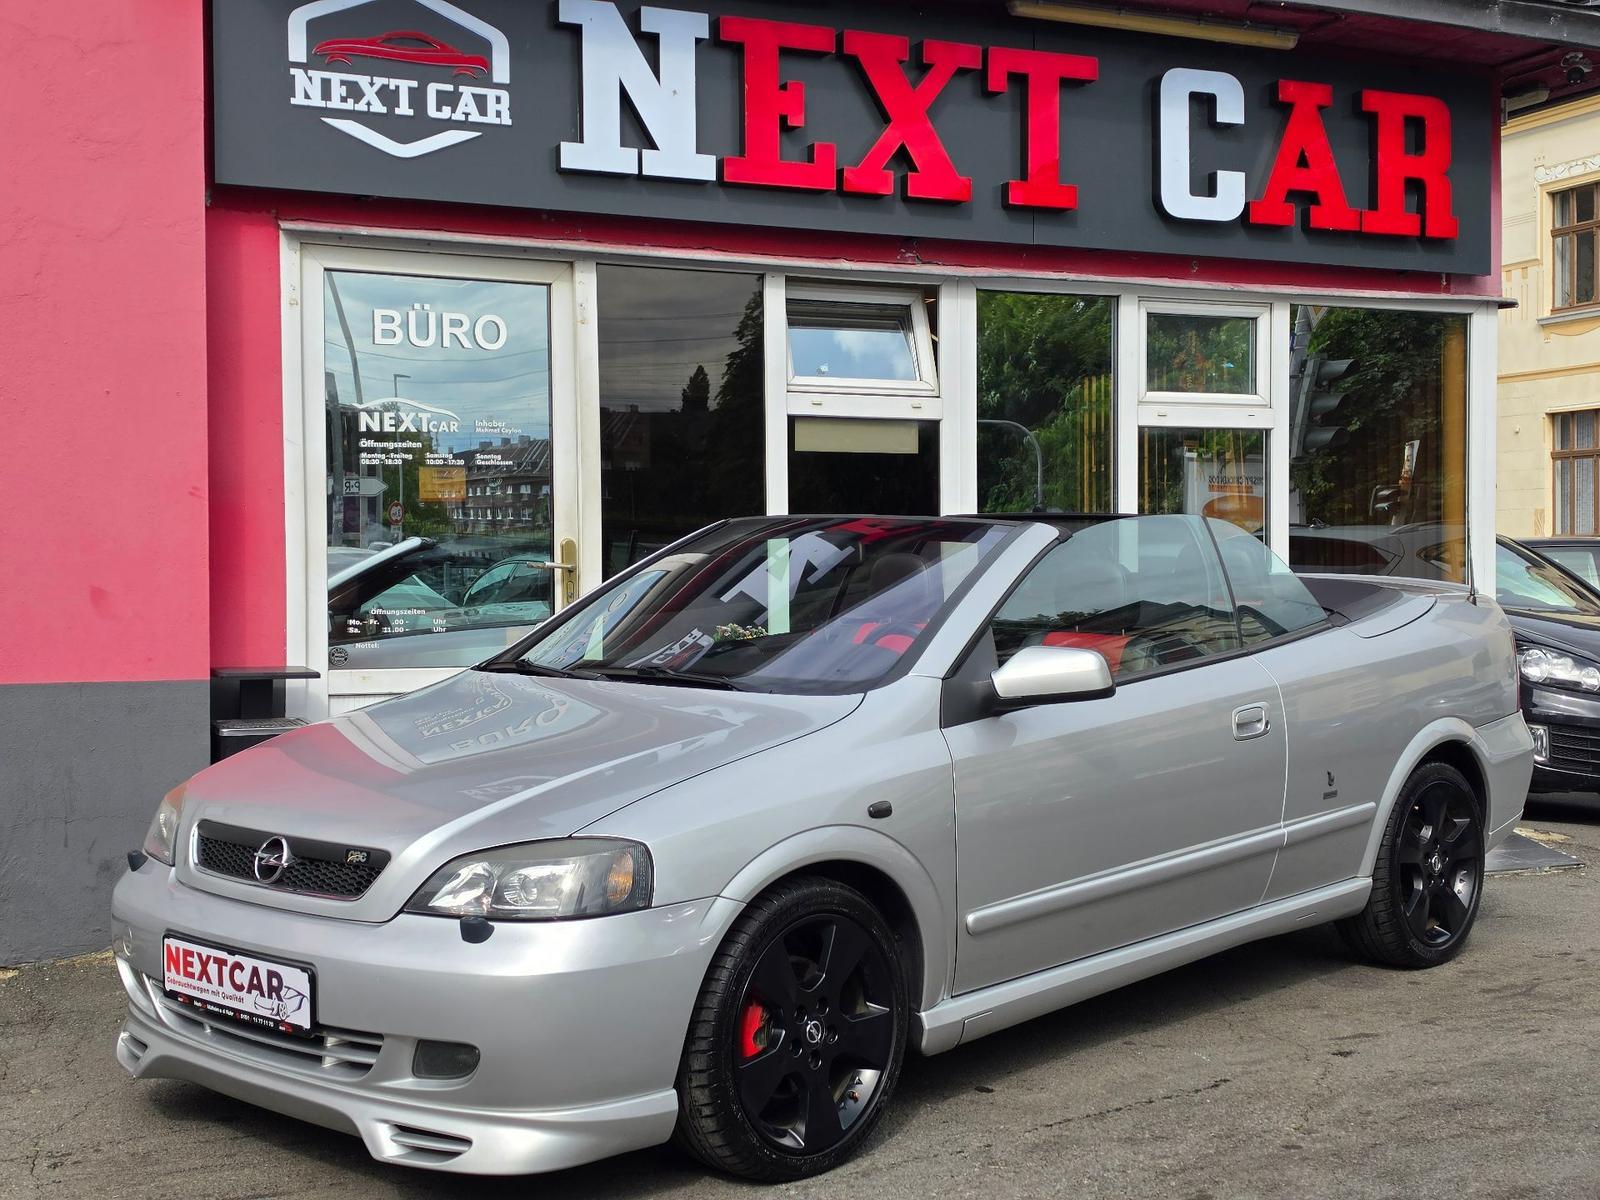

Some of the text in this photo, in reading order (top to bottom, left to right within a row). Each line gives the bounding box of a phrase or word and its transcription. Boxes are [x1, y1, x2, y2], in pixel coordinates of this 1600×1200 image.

[289, 68, 512, 126] NEXT CAR
[558, 0, 1459, 240] NEXT CAR
[373, 303, 508, 350] BÜRO
[359, 438, 422, 449] Öffnungszeiten
[360, 452, 386, 460] Montag
[370, 608, 426, 616] Öffnungszeiten
[166, 943, 284, 1002] NEXTCAR
[167, 976, 245, 1004] Gebrauchtwagen mit Qualität
